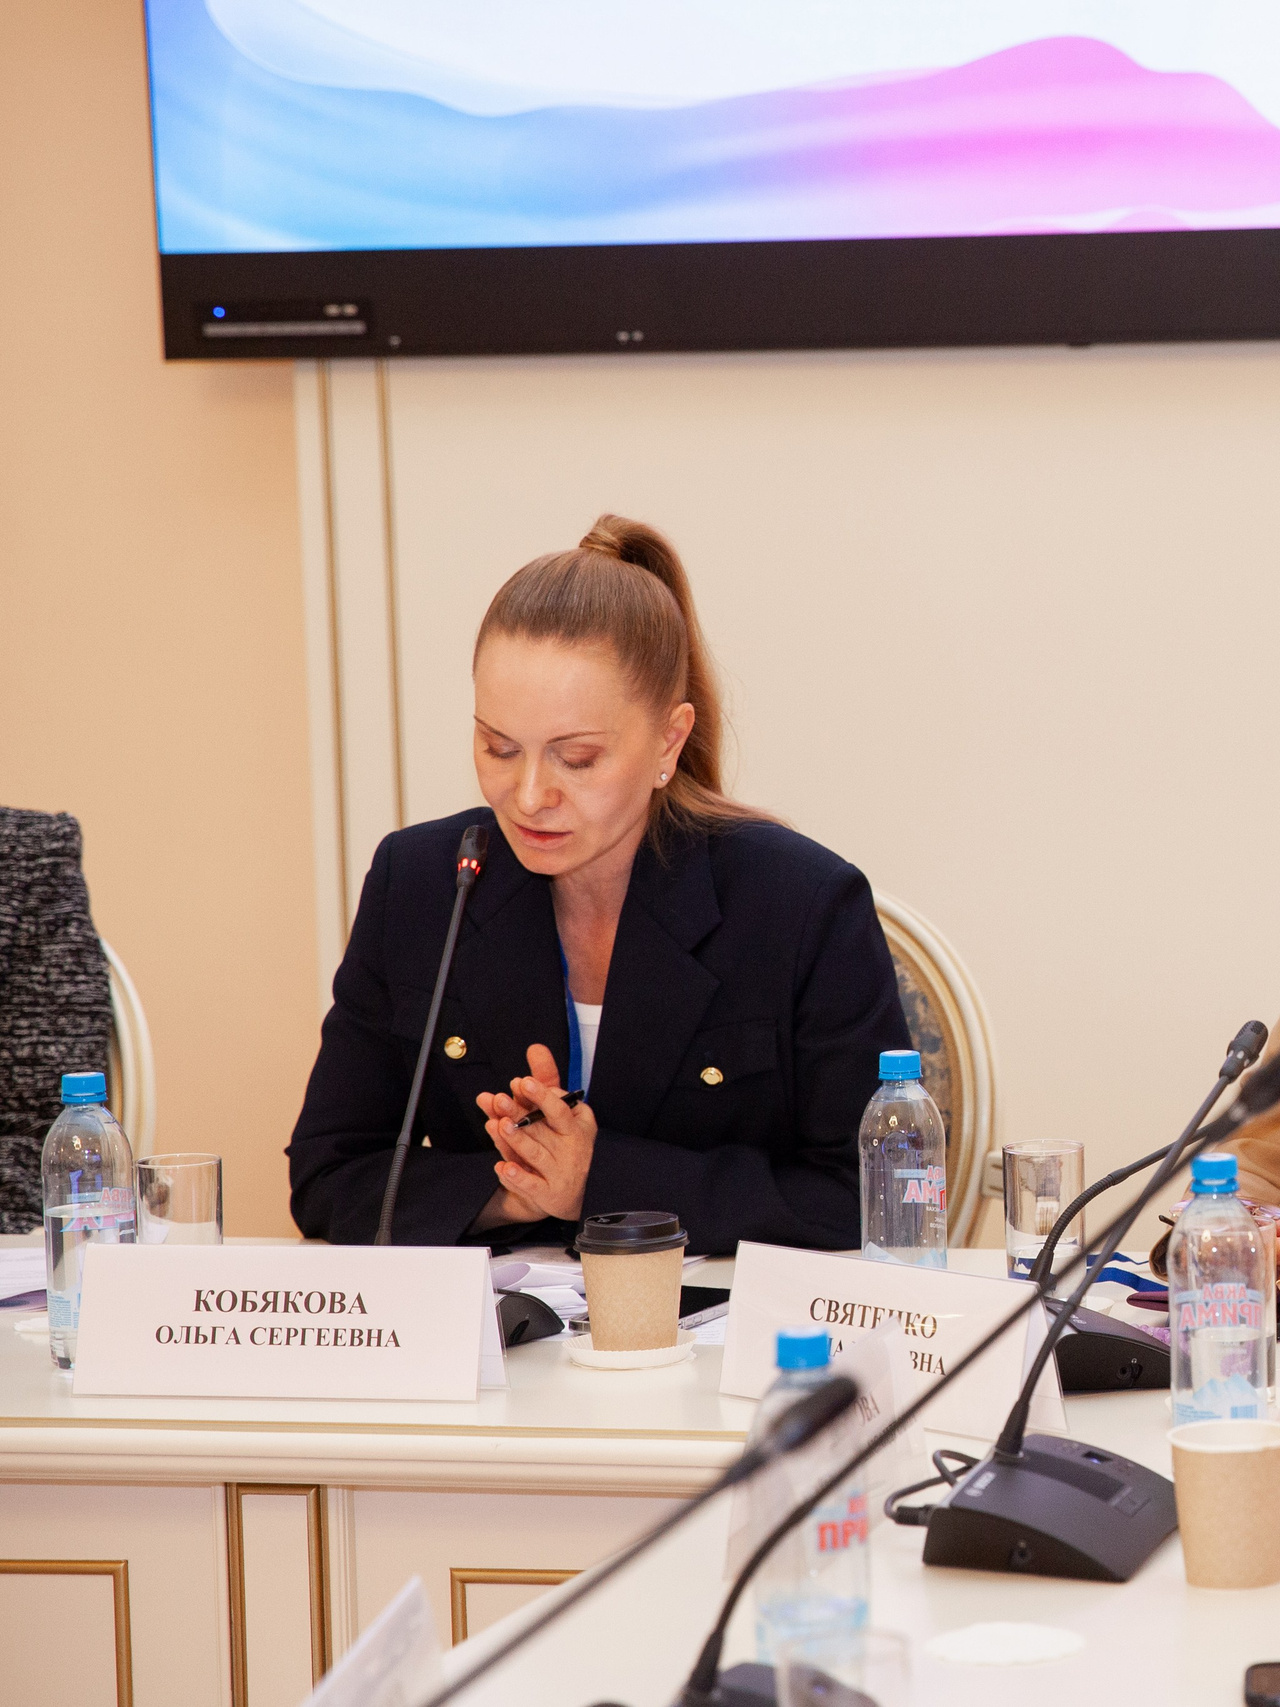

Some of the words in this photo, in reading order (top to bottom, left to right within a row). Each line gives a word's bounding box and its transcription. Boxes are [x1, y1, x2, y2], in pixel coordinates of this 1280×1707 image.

[193, 1289, 368, 1315] КОБЯКОВА
[155, 1325, 242, 1345] ОЛЬГА
[249, 1326, 401, 1348] СЕРГЕЕВНА
